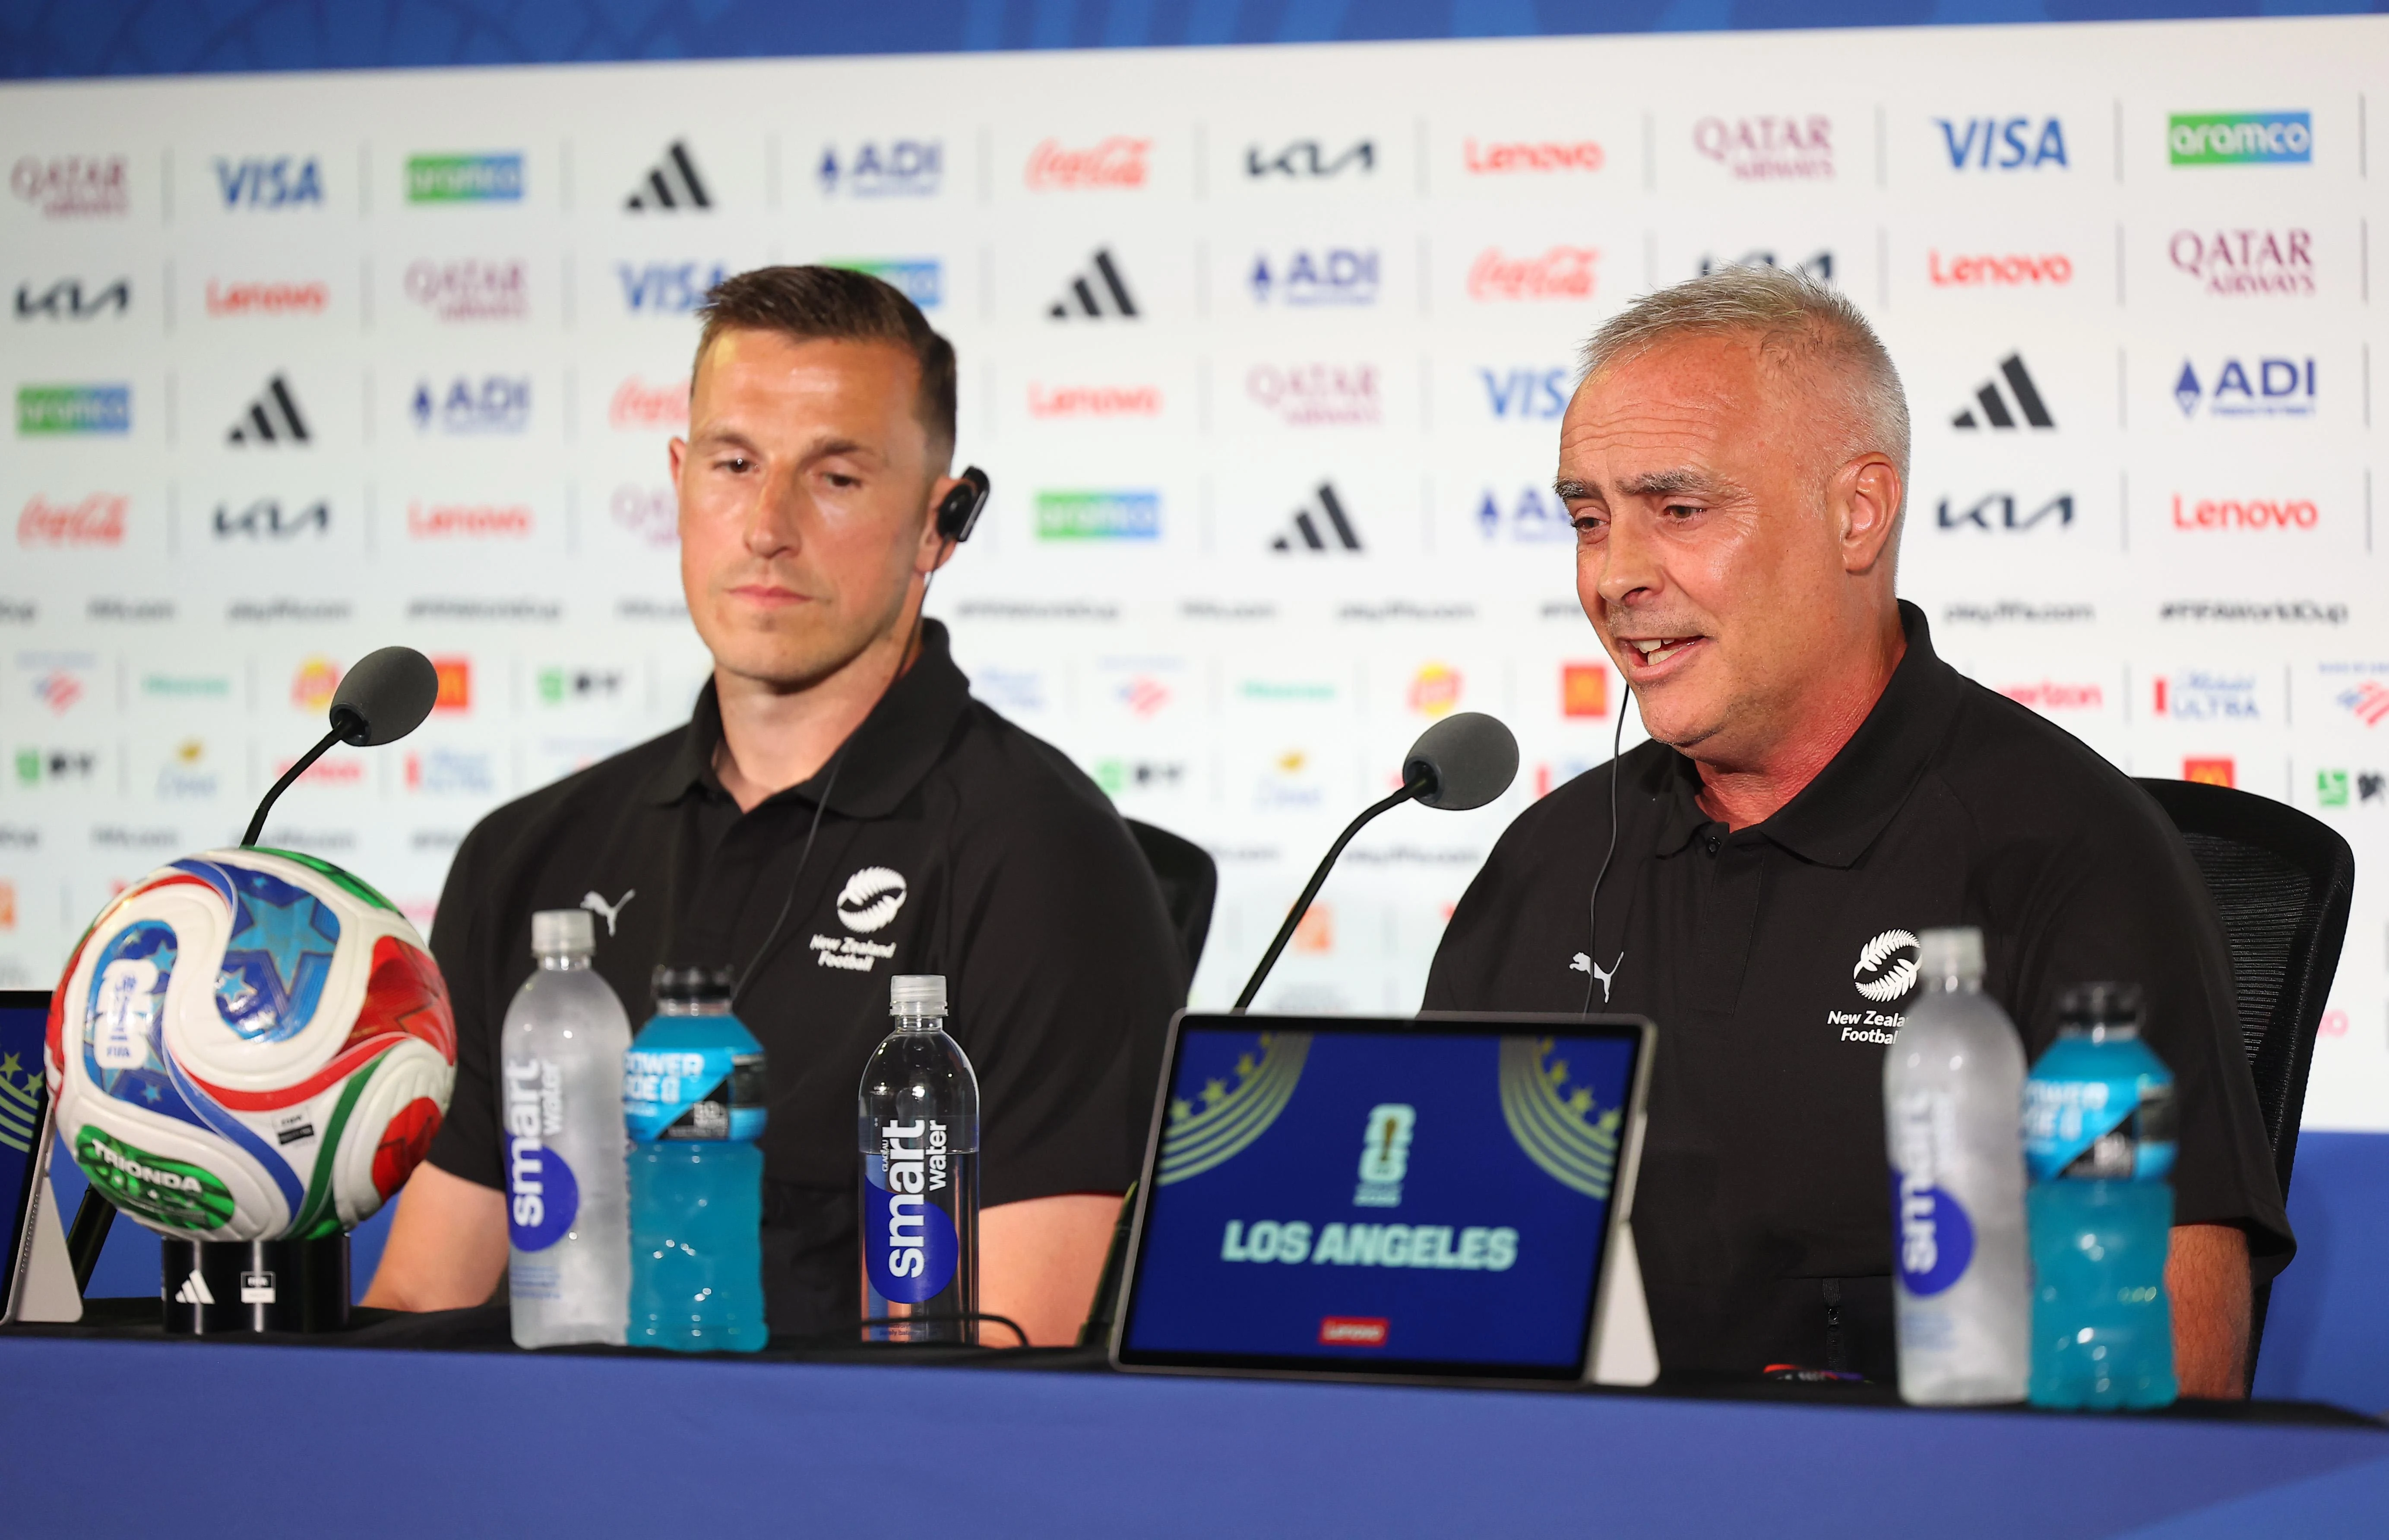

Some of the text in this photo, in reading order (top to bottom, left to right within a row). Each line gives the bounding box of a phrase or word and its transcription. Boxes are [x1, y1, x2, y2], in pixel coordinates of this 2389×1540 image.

[853, 140, 940, 174] ADI
[1465, 139, 1604, 174] Lenovo
[1693, 114, 1832, 164] QATAR
[1937, 117, 2068, 170] VISA
[2171, 122, 2310, 155] aramco
[212, 156, 324, 208] VISA
[1287, 250, 1378, 287] ADI
[1929, 250, 2072, 287] Lenovo
[2169, 230, 2313, 277] QATAR
[206, 281, 326, 317] Lenovo
[445, 379, 529, 412] ADI
[1479, 368, 1568, 417] VIS
[2214, 360, 2315, 396] ADI
[1030, 383, 1159, 417] Lenovo
[408, 501, 531, 538] Lenovo
[2173, 495, 2318, 529] Lenovo
[810, 934, 897, 958] New Zealand
[818, 949, 875, 972] Football
[1827, 1010, 1908, 1028] New Zeala
[1841, 1027, 1900, 1045] Footbal
[506, 1058, 545, 1228] smart
[925, 1119, 947, 1192] water
[91, 1138, 203, 1193] TRIONDA
[881, 1119, 925, 1279] smart
[1221, 1219, 1520, 1272] LOS ANGELES
